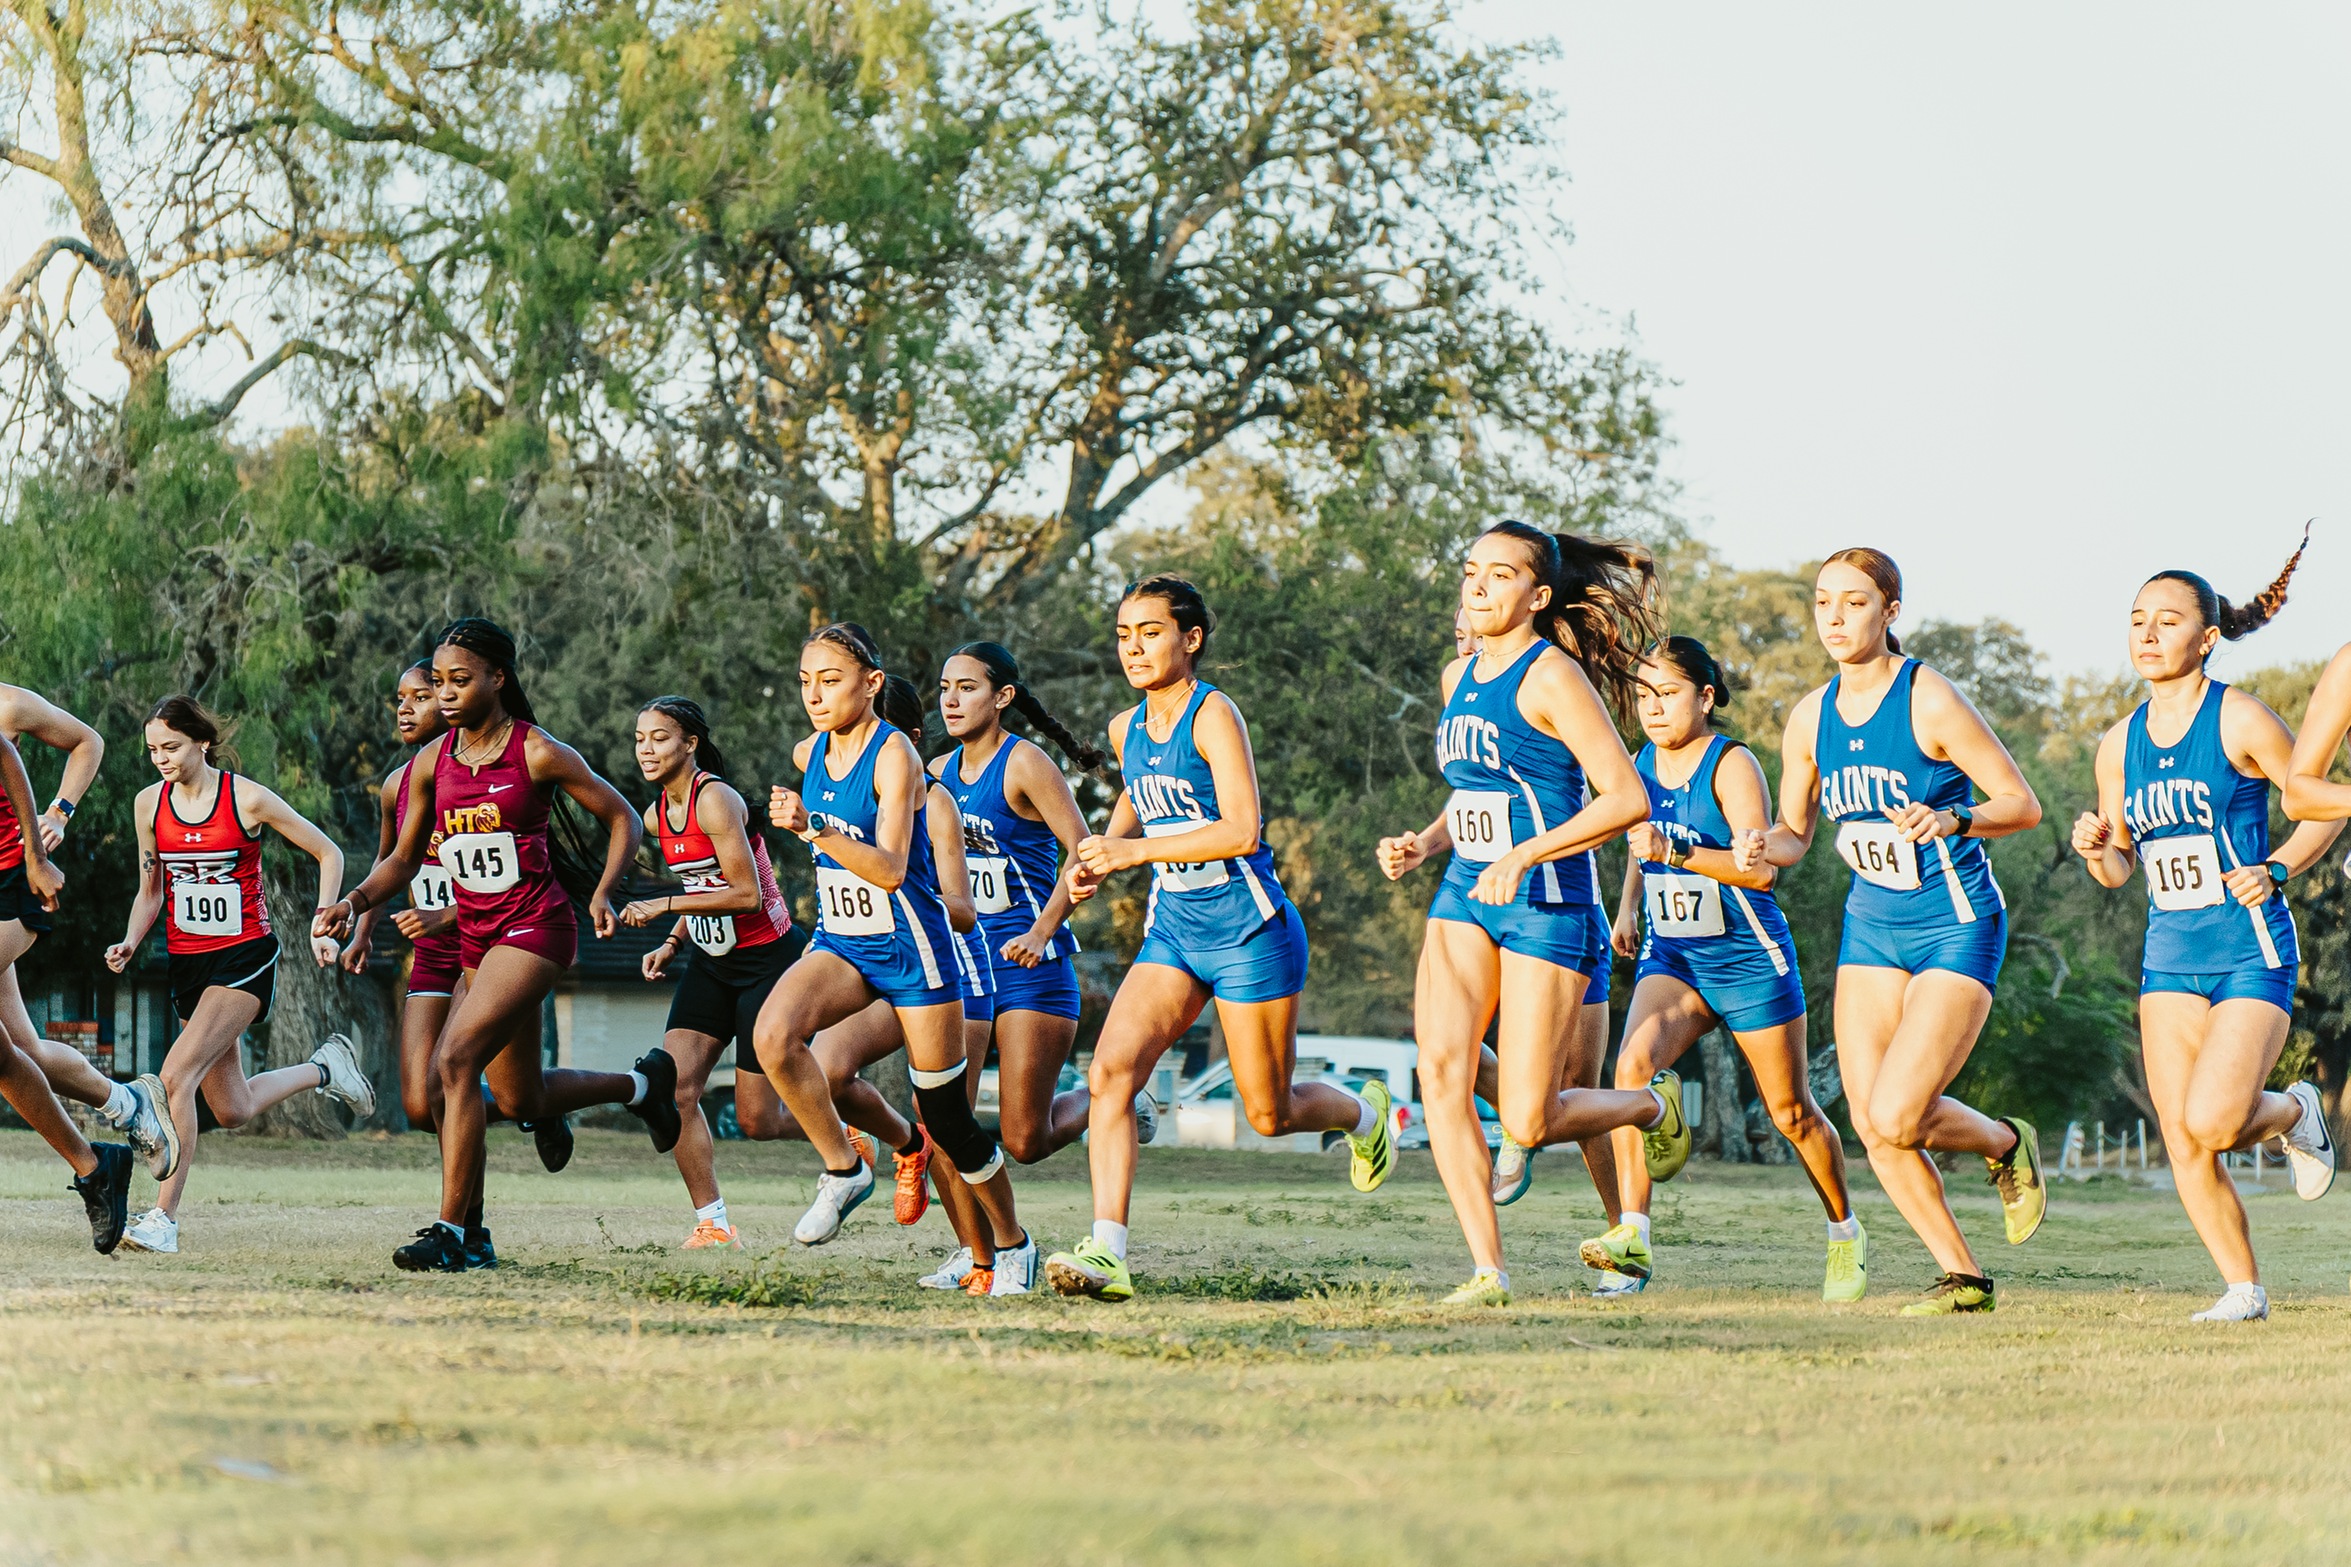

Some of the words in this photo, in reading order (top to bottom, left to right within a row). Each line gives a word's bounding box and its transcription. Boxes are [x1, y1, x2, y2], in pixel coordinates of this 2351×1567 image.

[1821, 765, 1910, 822] SAINTS
[2124, 779, 2214, 842] SAINTS
[1456, 808, 1494, 844] 160
[453, 847, 504, 879] 145
[1851, 839, 1900, 874] 164
[2155, 854, 2203, 892] 165
[422, 877, 450, 907] 14
[827, 884, 873, 919] 168
[969, 869, 995, 900] 70
[185, 895, 227, 923] 190
[1657, 889, 1703, 922] 167
[691, 916, 726, 945] 203
